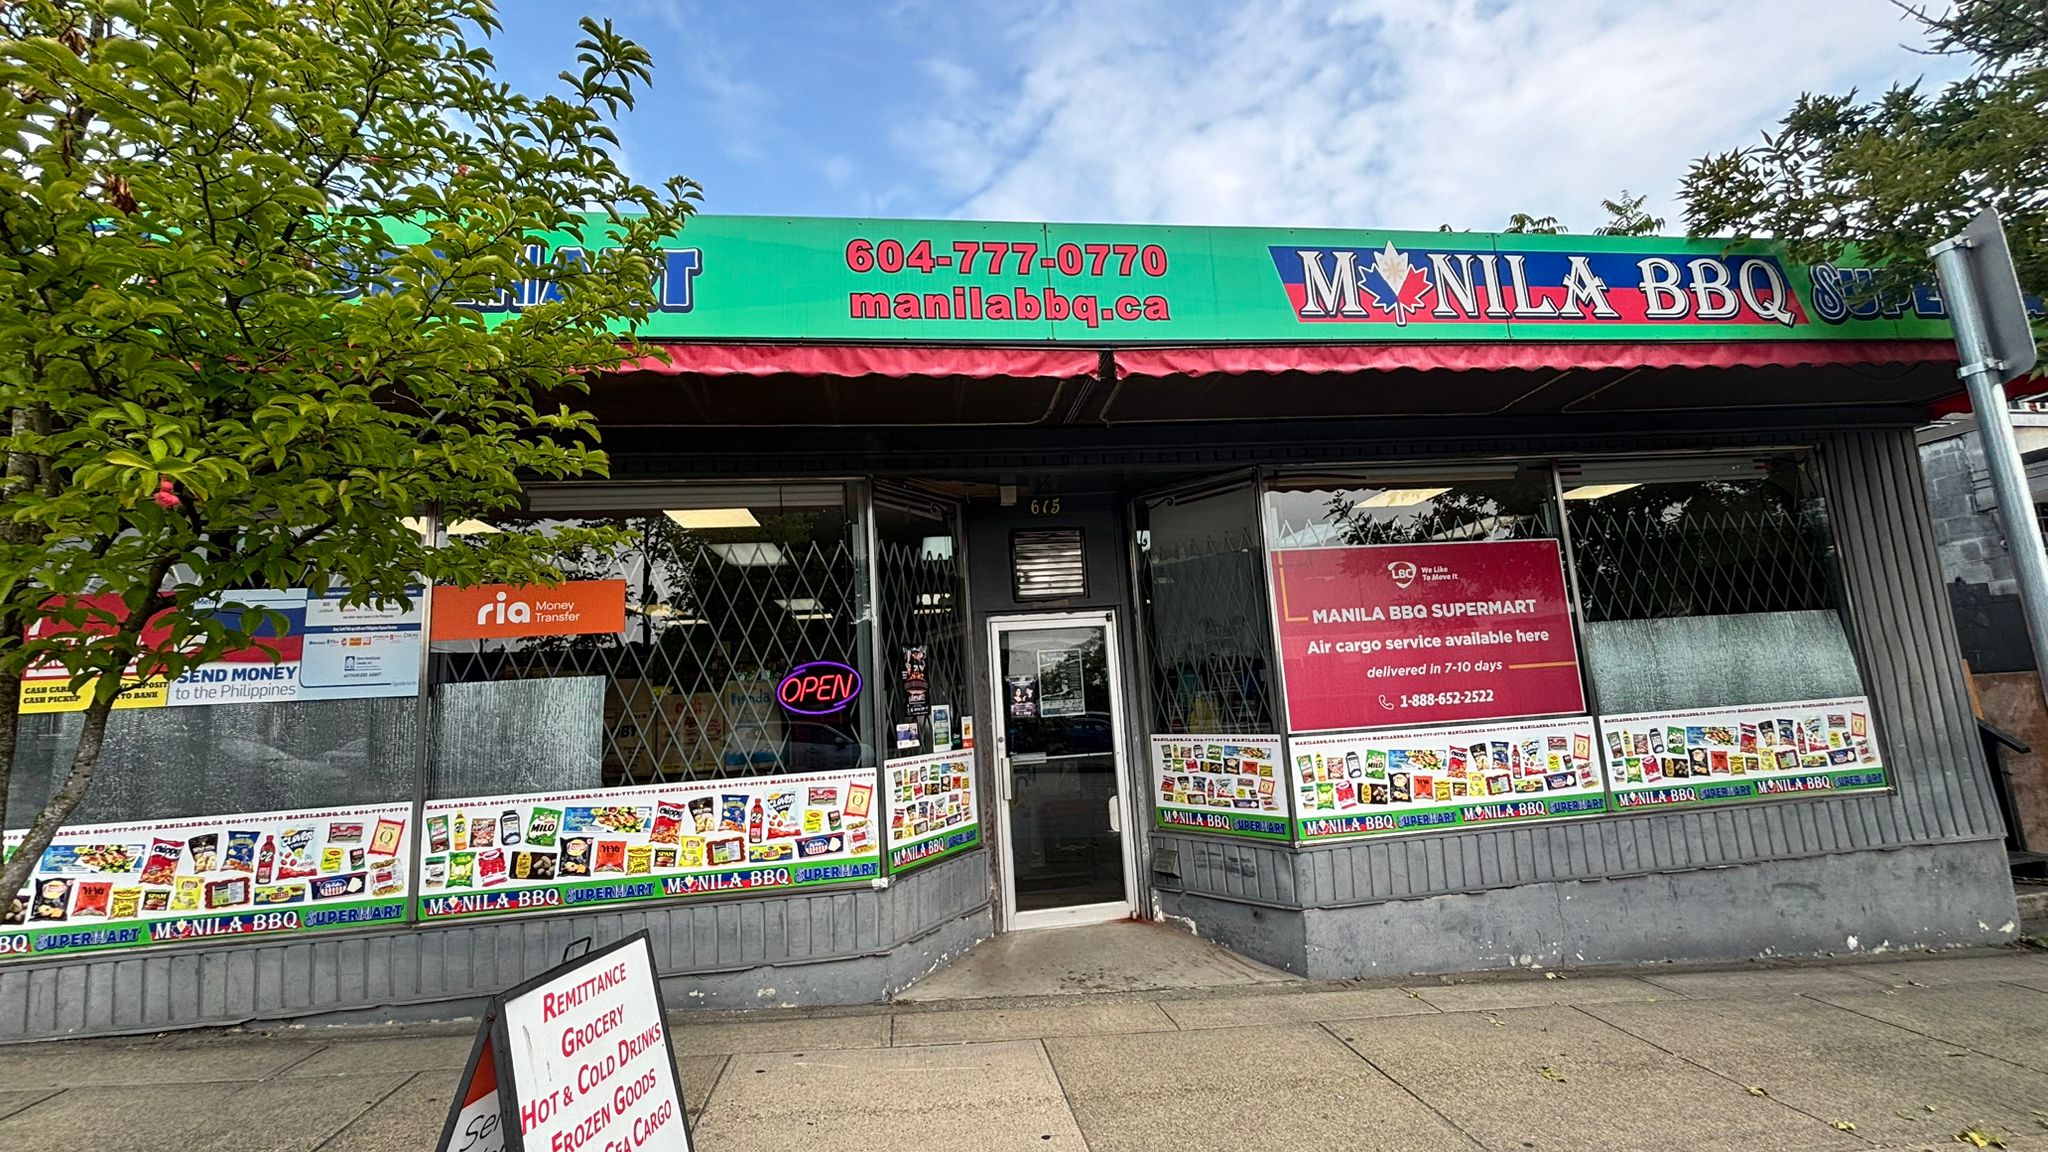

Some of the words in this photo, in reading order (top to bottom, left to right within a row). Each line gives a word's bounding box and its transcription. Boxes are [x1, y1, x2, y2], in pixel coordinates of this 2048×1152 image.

[846, 239, 1168, 277] 604-777-0770
[1636, 257, 1796, 328] BBQ
[850, 286, 1171, 328] manilabbq.ca
[1391, 568, 1414, 580] LBC
[1433, 565, 1448, 573] Like
[477, 591, 531, 625] ria
[535, 600, 575, 611] Money
[1312, 605, 1386, 624] MANILA
[1389, 603, 1428, 621] BBQ
[1431, 599, 1537, 617] SUPERMART
[535, 612, 580, 623] Transfer
[1307, 641, 1332, 655] Air
[1335, 640, 1382, 655] cargo
[1385, 634, 1442, 650] service
[1445, 629, 1513, 648] available
[1516, 629, 1550, 643] here
[177, 667, 229, 683] SEND
[230, 666, 298, 682] MONEY
[1366, 663, 1427, 678] delivered
[1429, 663, 1442, 675] in
[1444, 662, 1472, 674] 7-10
[1474, 659, 1503, 675] days
[134, 691, 158, 699] BANK
[176, 686, 189, 700] to
[192, 684, 217, 698] the
[220, 681, 297, 699] Philippines
[782, 672, 853, 703] OPEN
[1400, 689, 1494, 708] 1-888-652-2522
[23, 696, 47, 704] CASH
[426, 800, 487, 810] MANILABBQ.CA
[544, 793, 603, 802] MANILABBQ.CA
[658, 784, 717, 793] MANILABBQ.CA
[770, 776, 826, 785] MANILABBQ.CA
[1670, 788, 1696, 801] BBQ
[1807, 776, 1832, 790] BBQ
[155, 820, 224, 830] MANILABBQ.CA
[286, 810, 352, 820] MANILABBQ.CA
[750, 812, 762, 824] C2
[1207, 814, 1230, 829] BBQ
[1365, 814, 1394, 830] BBQ
[1518, 800, 1546, 816] BBQ
[530, 823, 555, 833] MILO
[154, 844, 180, 857] Chippy
[260, 850, 273, 863] C2
[928, 837, 945, 855] BBQ
[518, 888, 560, 908] BBQ
[566, 882, 655, 904] SUPERMART
[750, 868, 789, 886] BBQ
[795, 862, 878, 883] SUPERMART
[35, 928, 139, 951] SUPERMART
[253, 911, 298, 931] BBQ
[304, 904, 403, 928] SUPERMART
[542, 962, 627, 1024] REMITTANCE
[561, 1003, 625, 1059] GROCERY
[521, 1090, 560, 1136] HOT
[563, 1085, 574, 1107] &
[577, 1055, 615, 1095] COLD
[618, 1022, 662, 1068] DRINKS
[613, 1067, 657, 1117] GOODS
[633, 1099, 672, 1148] CARGO
